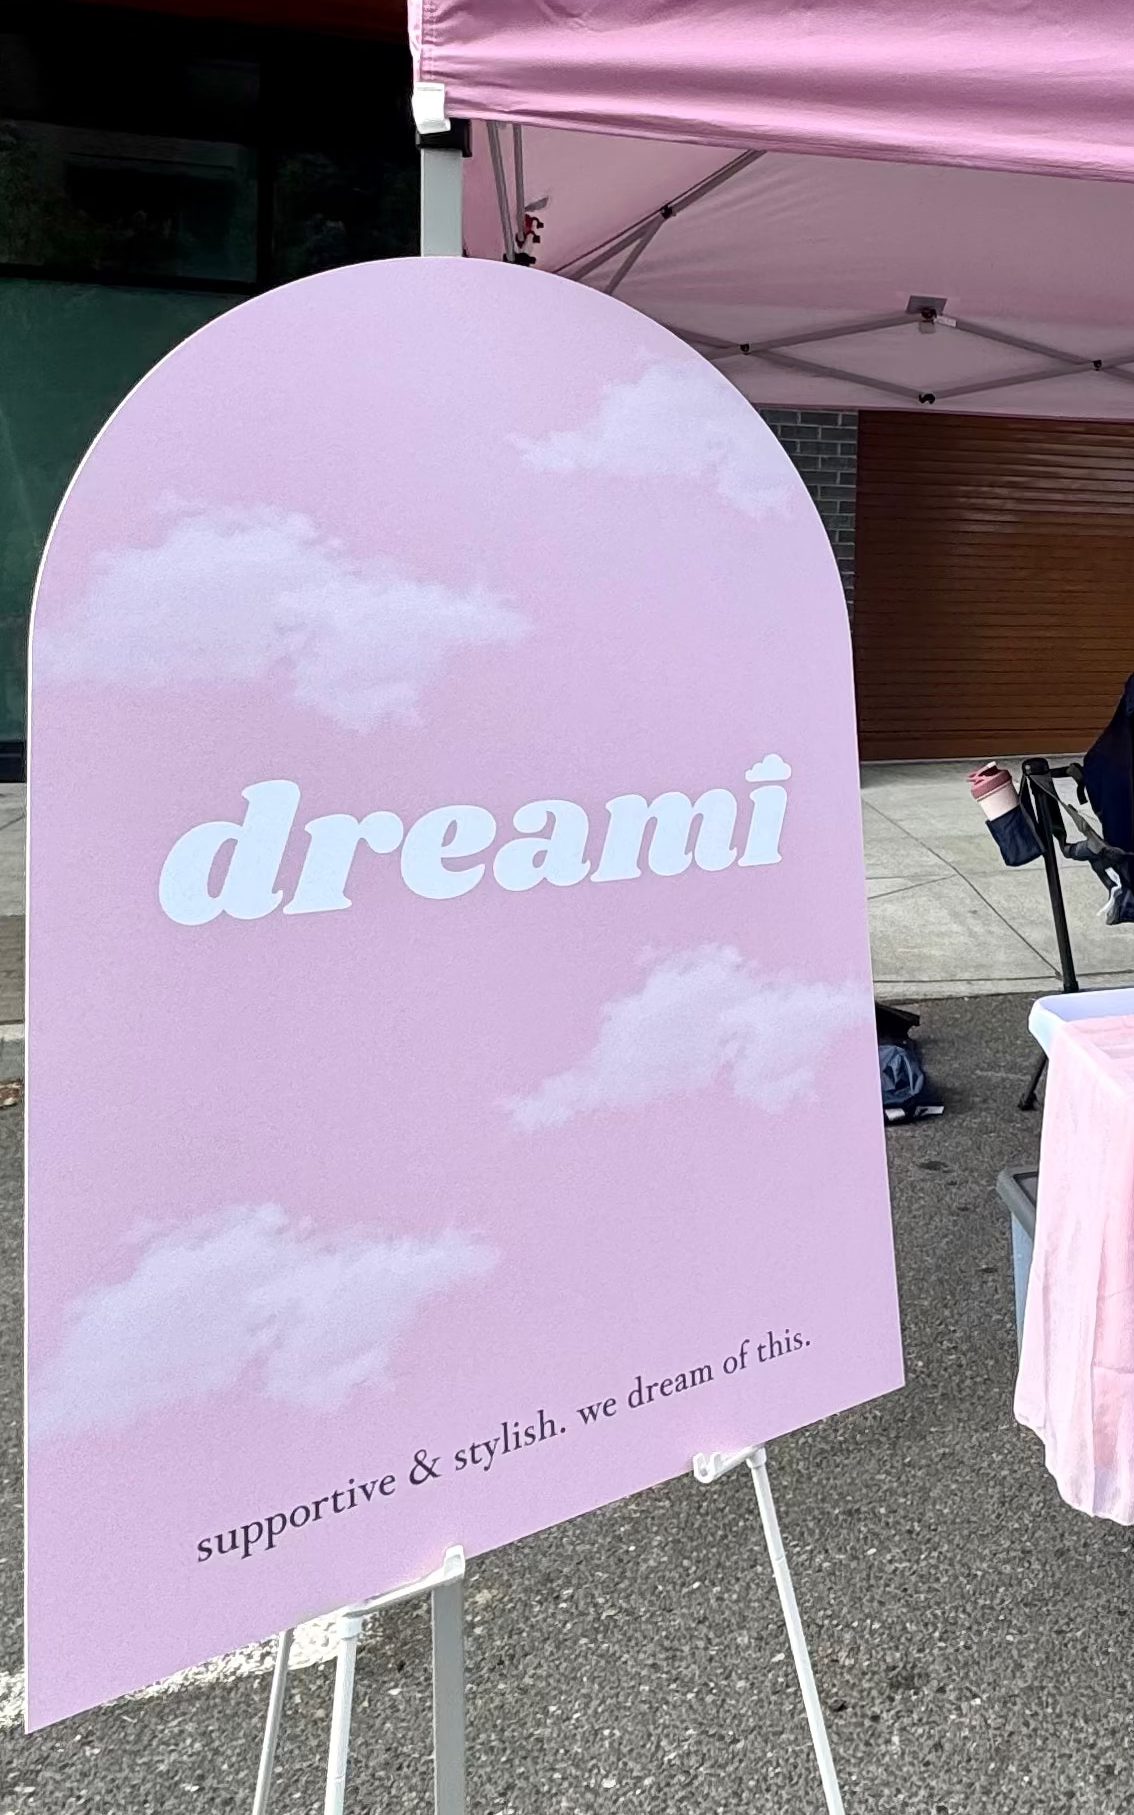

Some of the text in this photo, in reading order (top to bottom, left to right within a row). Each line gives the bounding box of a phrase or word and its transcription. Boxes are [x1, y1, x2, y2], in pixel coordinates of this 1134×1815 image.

[159, 754, 792, 926] dreami
[196, 1328, 811, 1562] supportive & stylish. we dream of this.
